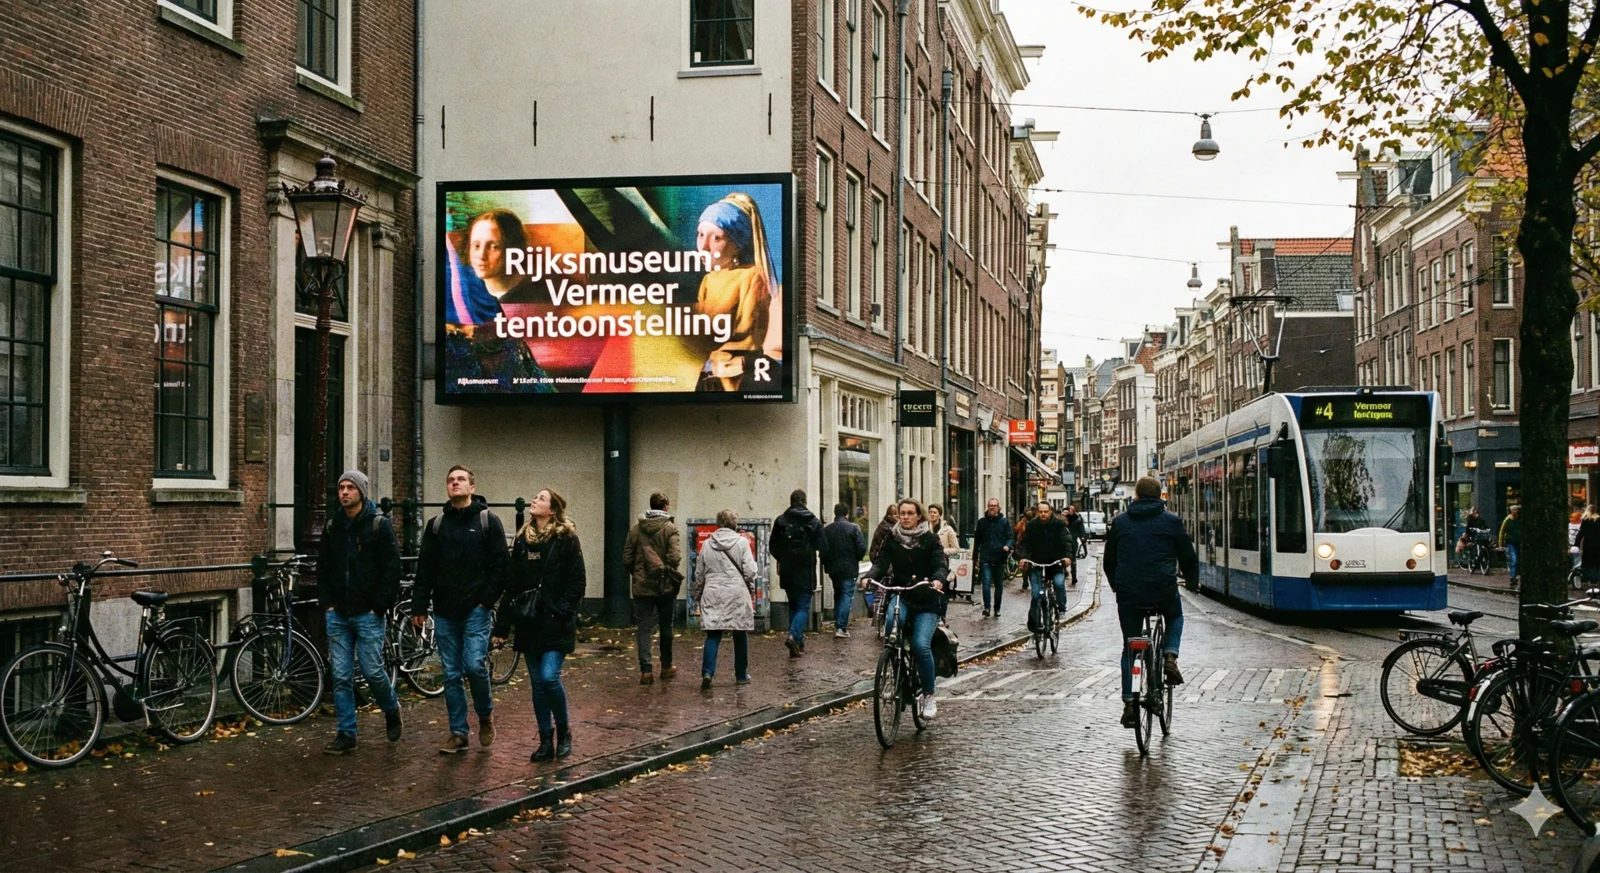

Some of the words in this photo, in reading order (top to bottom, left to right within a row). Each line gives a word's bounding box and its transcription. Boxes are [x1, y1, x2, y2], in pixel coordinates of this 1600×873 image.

[504, 247, 723, 282] Rijksmuseum:
[546, 278, 679, 307] Vermeer
[494, 306, 732, 343] tentoonstelling
[754, 358, 772, 382] R
[1315, 402, 1334, 420] #4
